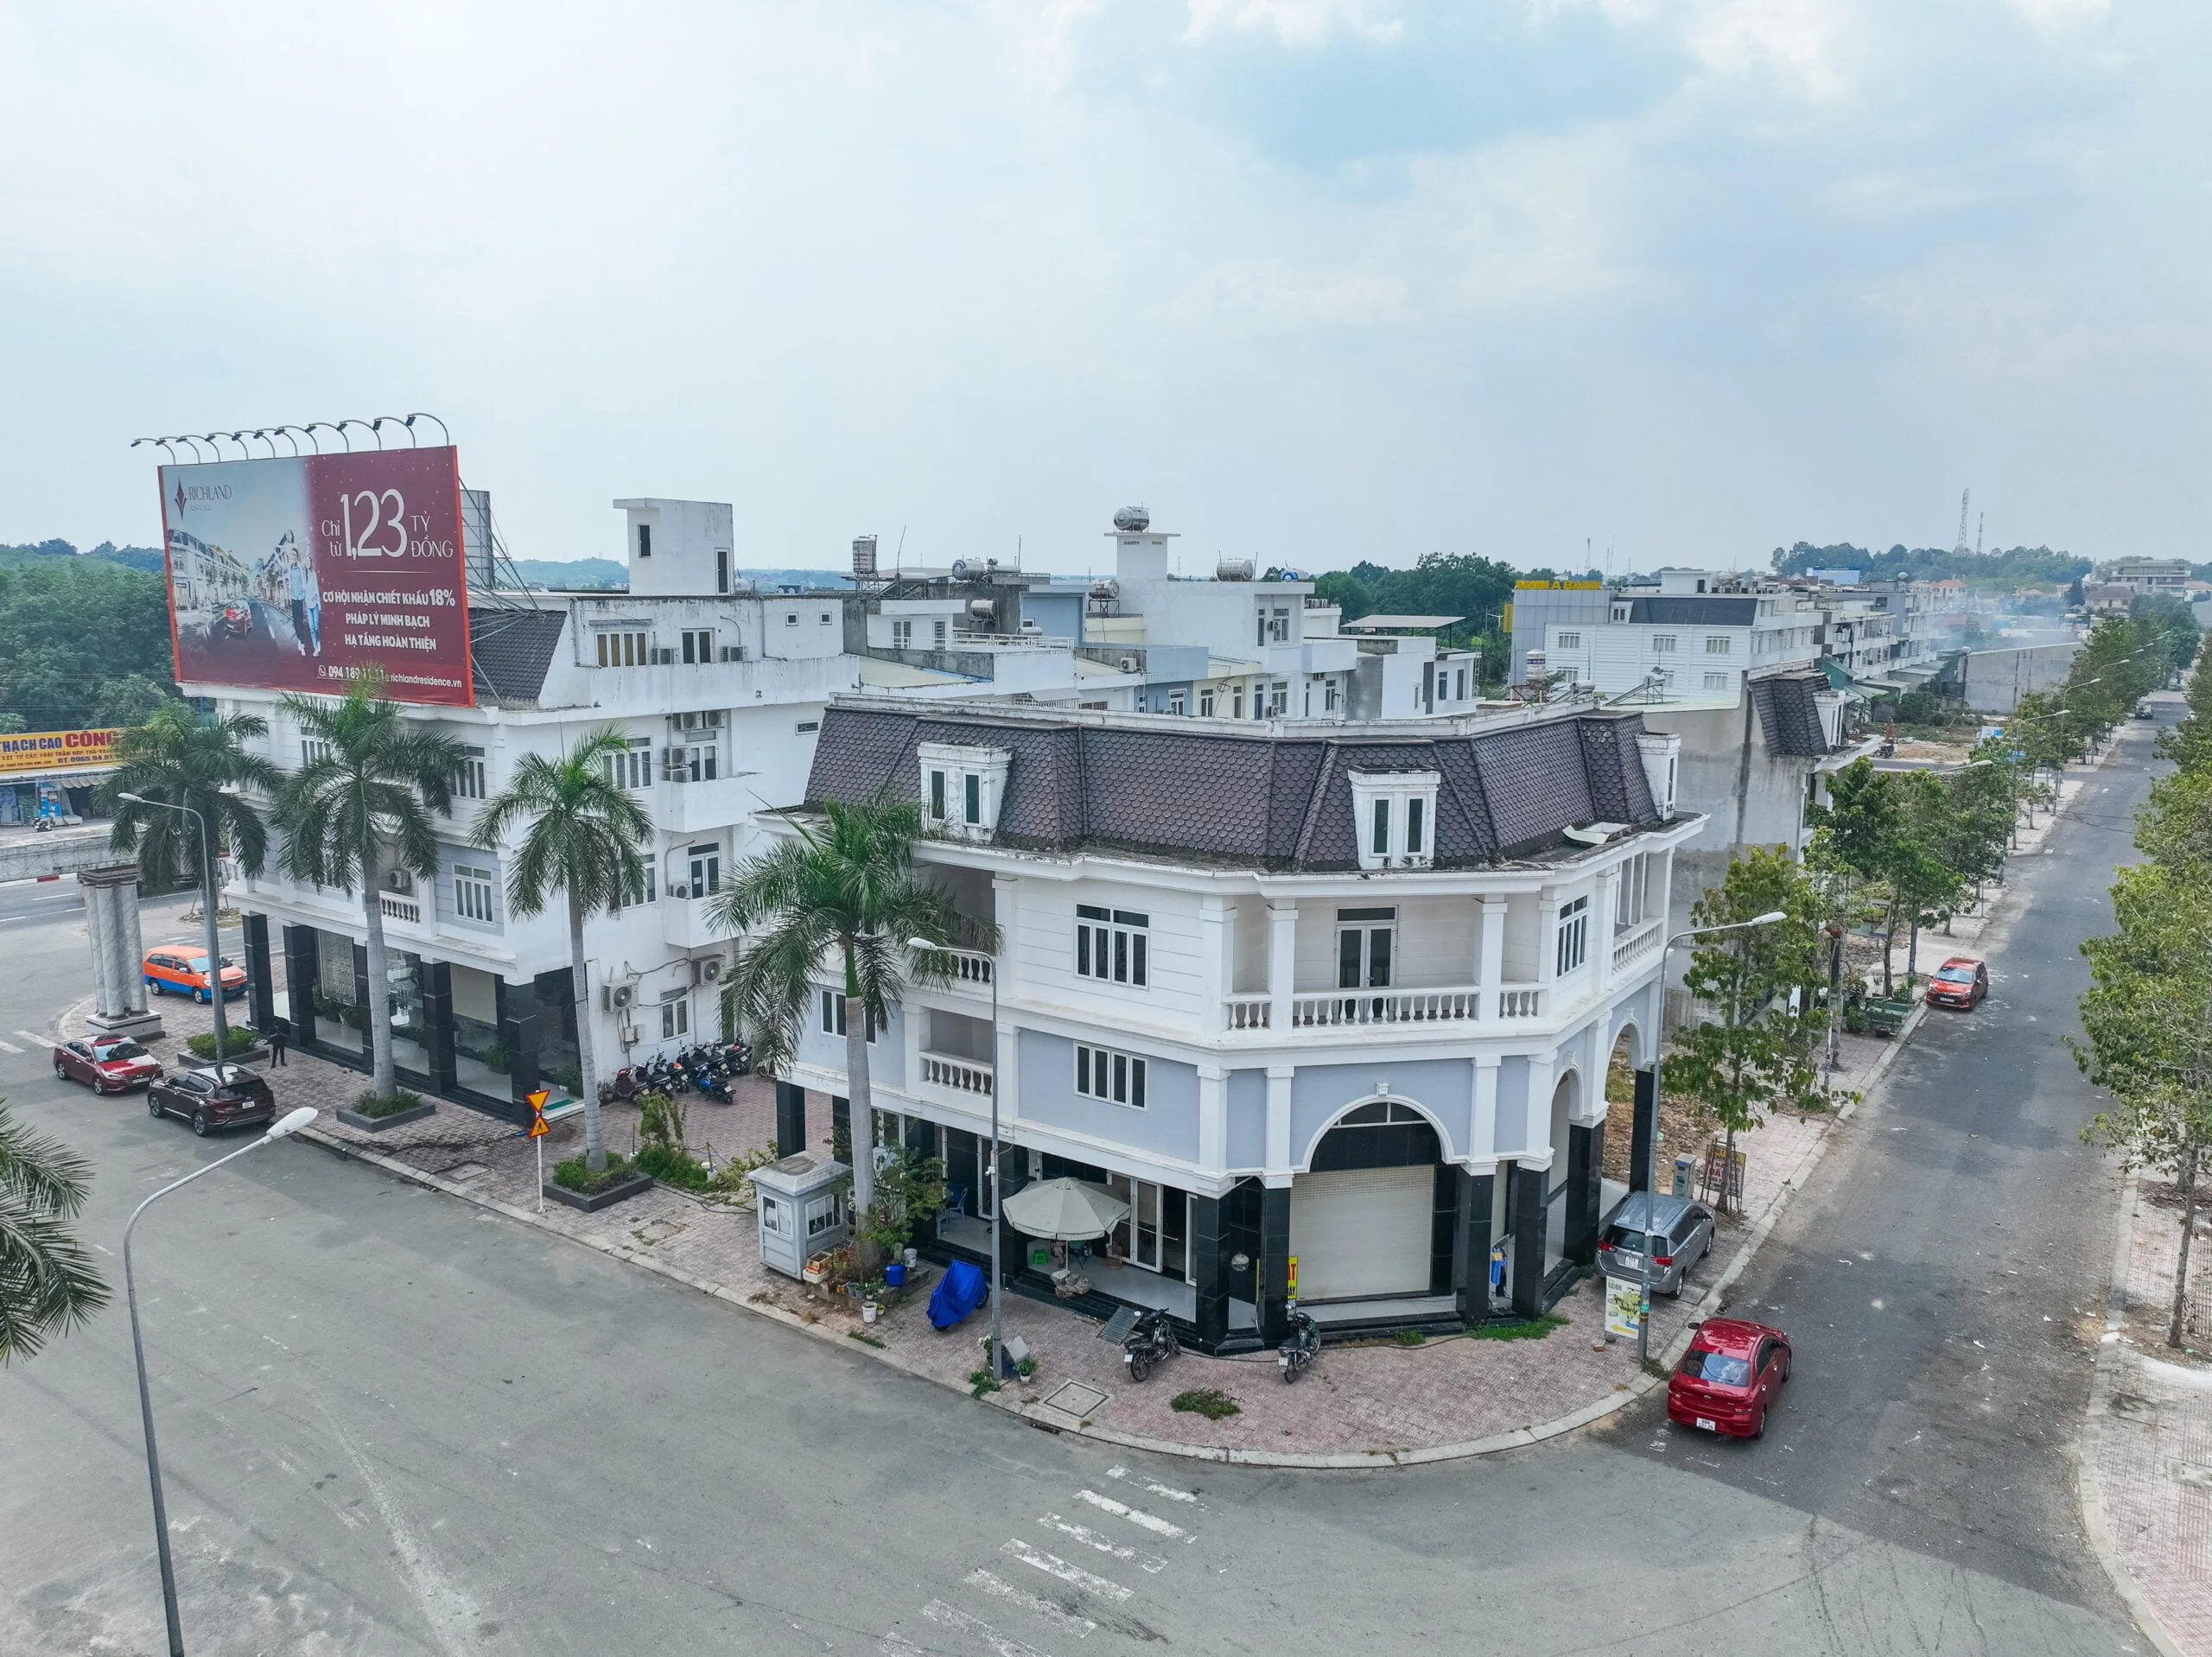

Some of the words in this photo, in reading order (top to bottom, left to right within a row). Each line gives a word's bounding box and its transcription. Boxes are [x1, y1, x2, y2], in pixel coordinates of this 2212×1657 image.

[188, 484, 232, 501] RICHLAND
[340, 488, 408, 561] 1,23
[410, 511, 430, 532] TỶ
[330, 541, 342, 557] từ
[410, 535, 454, 557] ĐỒNG
[335, 589, 350, 606] HỘI
[351, 589, 375, 606] NHẬN
[376, 588, 400, 605] CHIẾT
[402, 589, 429, 606] KHẤU
[429, 588, 456, 606] 18%
[346, 611, 368, 625] PHÁP
[369, 611, 379, 625] LÝ
[380, 615, 404, 627] MINH
[404, 615, 431, 630] BẠCH
[345, 633, 357, 648] HẠ
[382, 634, 410, 649] HOÀN
[410, 636, 437, 653] THIỆN
[328, 665, 344, 678] 094
[391, 673, 462, 689] richlandresidence.vn
[39, 737, 62, 750] CAO
